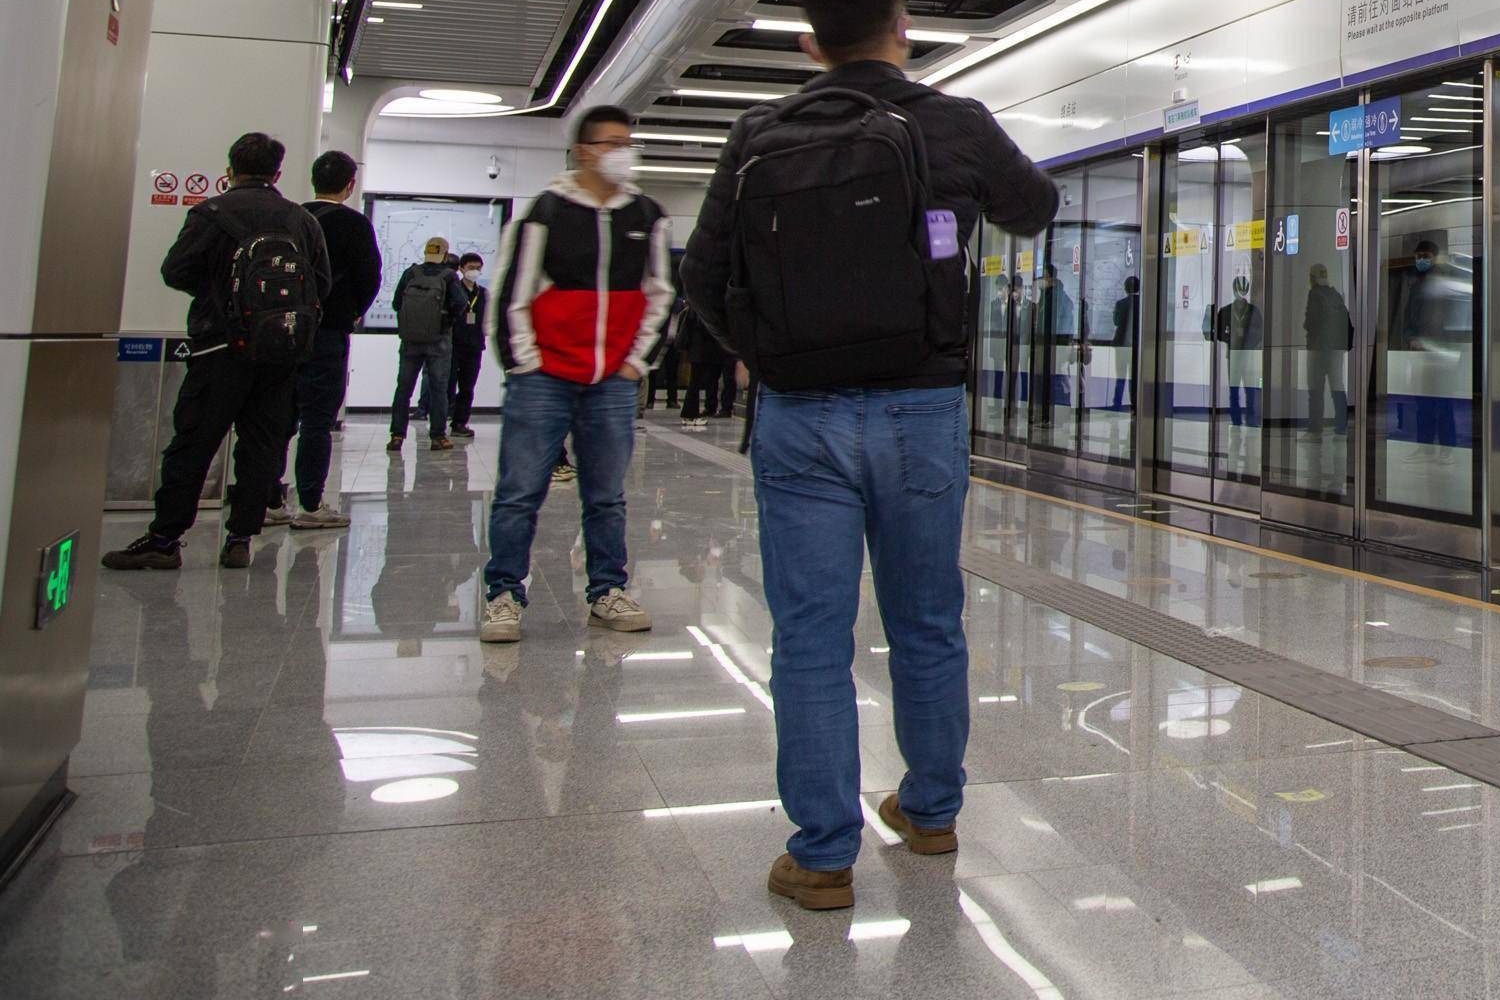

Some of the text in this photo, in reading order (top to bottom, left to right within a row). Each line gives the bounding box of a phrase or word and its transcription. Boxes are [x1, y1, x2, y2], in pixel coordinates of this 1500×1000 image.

[1347, 2, 1449, 40] Please wait at the opposite platform
